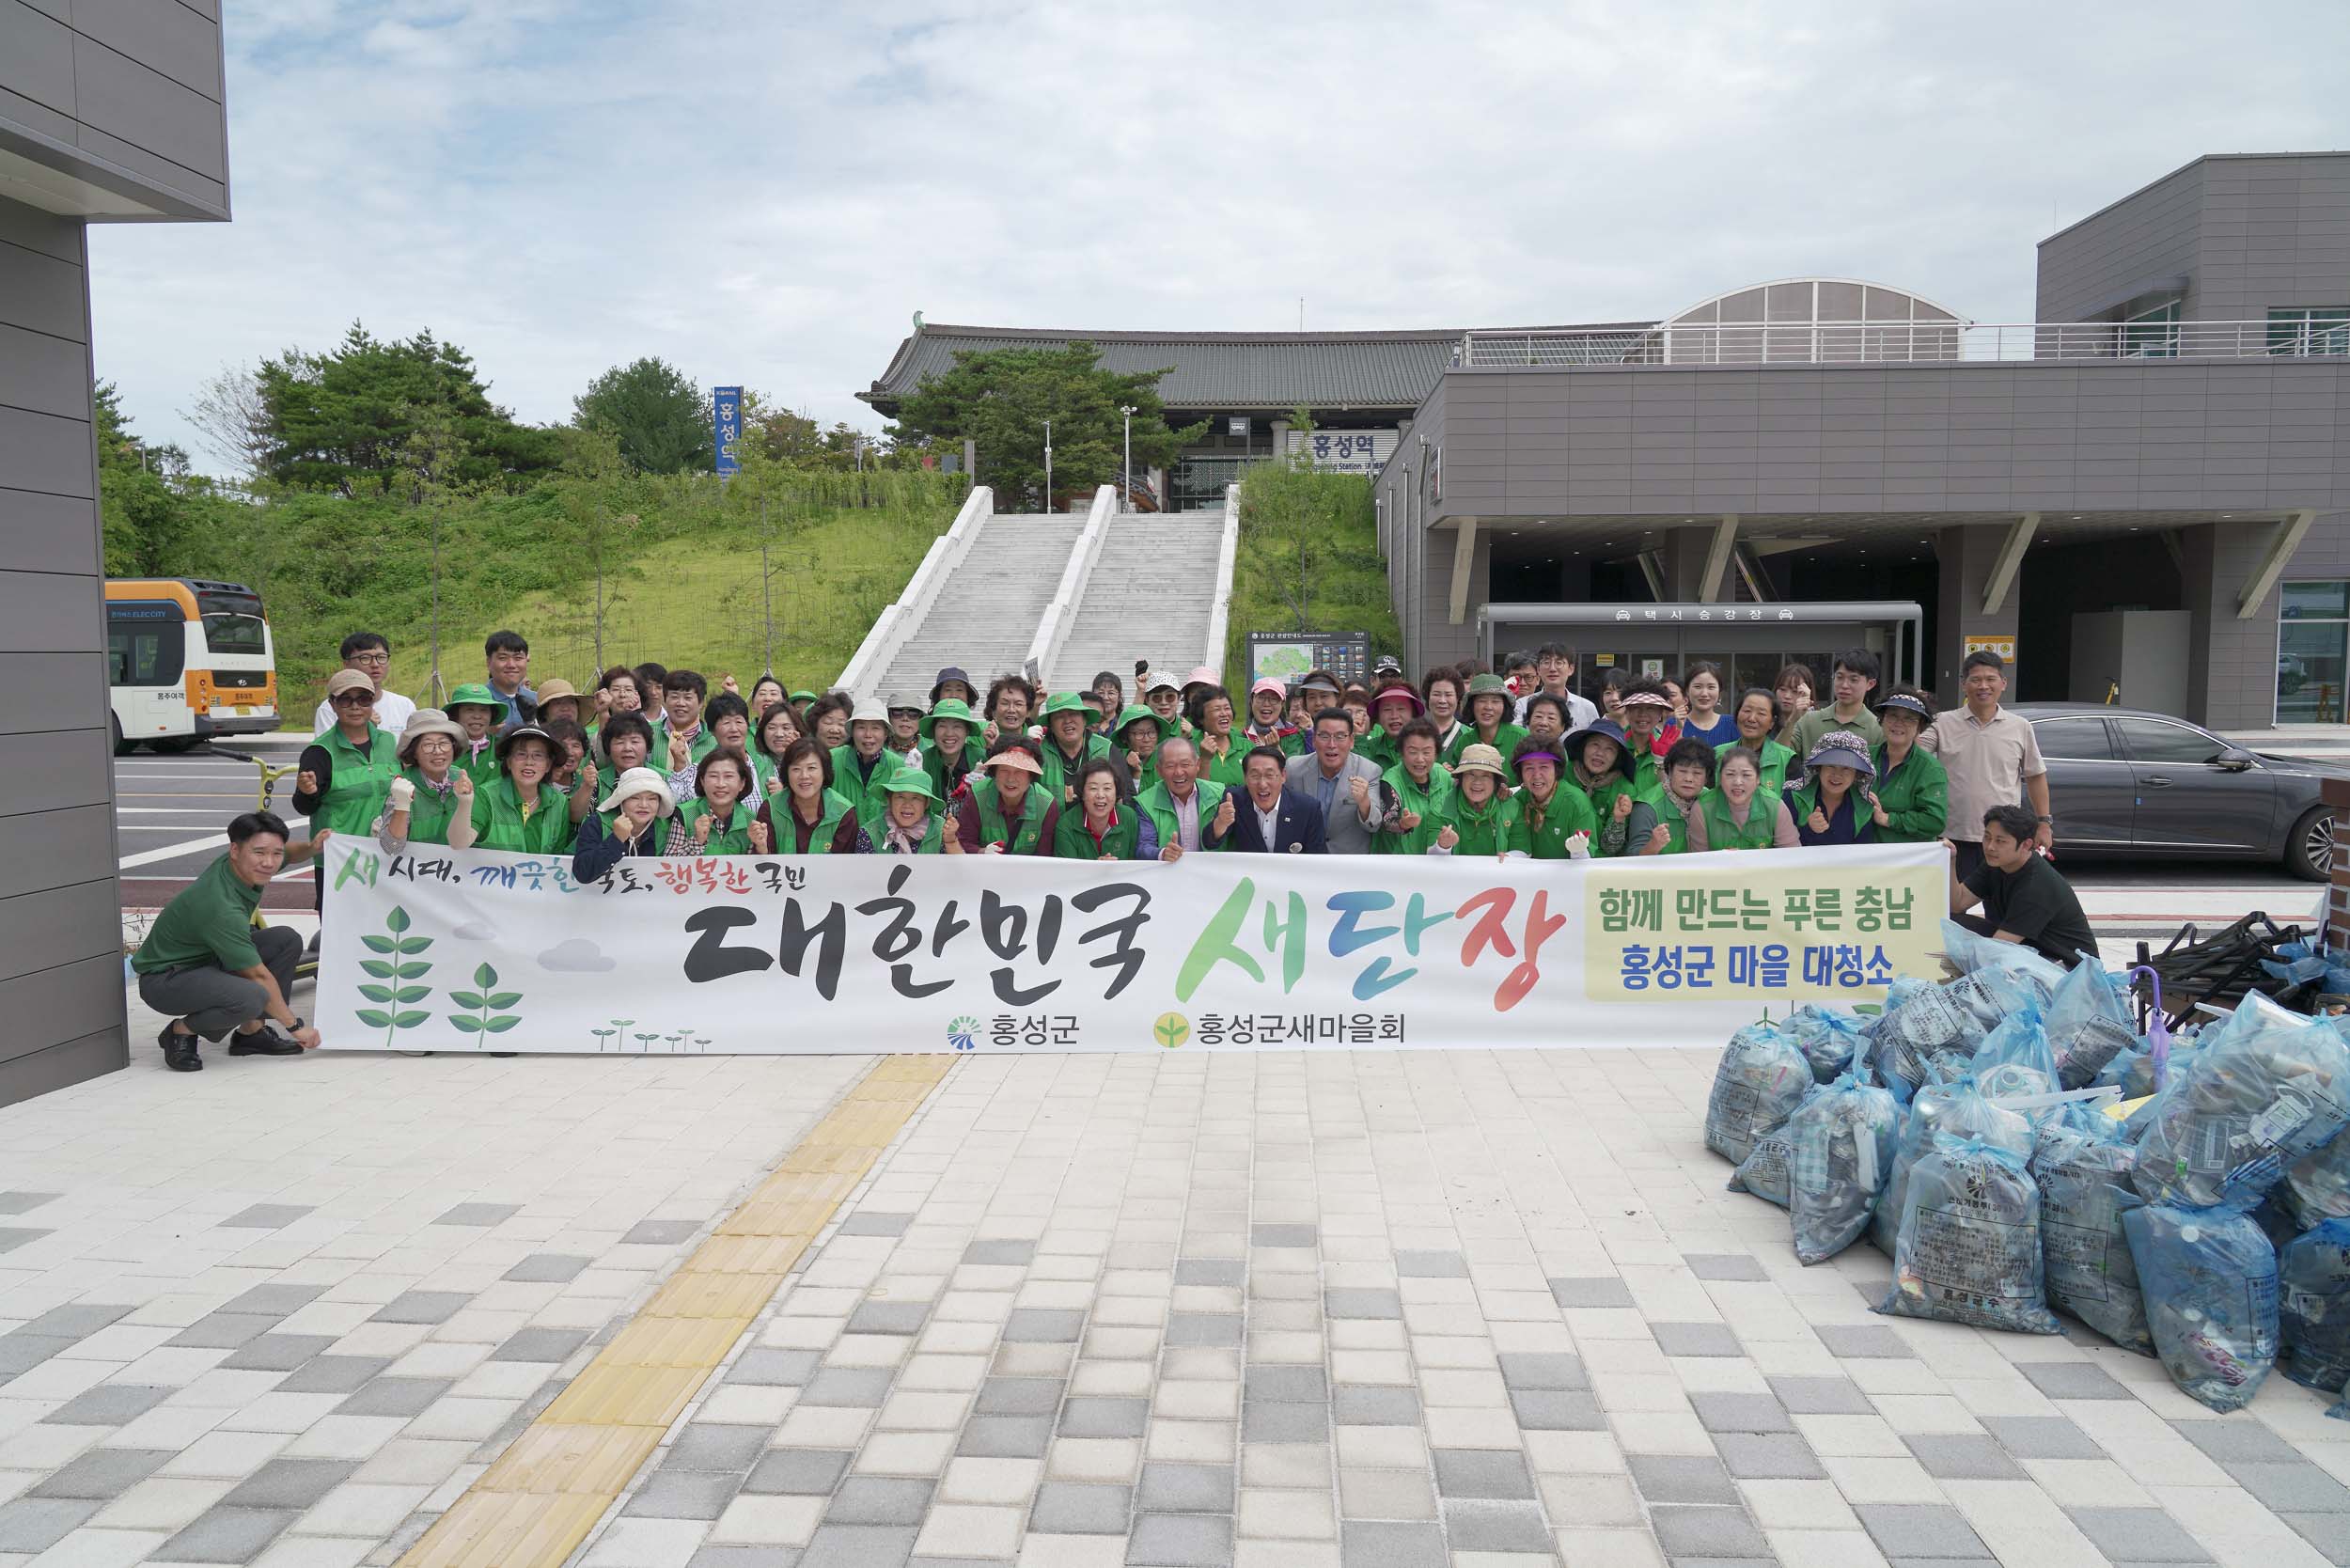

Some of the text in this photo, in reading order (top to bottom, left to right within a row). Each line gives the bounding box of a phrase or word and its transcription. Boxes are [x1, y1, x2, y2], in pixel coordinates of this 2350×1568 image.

[1312, 435, 1373, 458] 홍성역
[335, 847, 380, 892] 새
[388, 857, 461, 884] 시대,
[470, 857, 580, 893] 깨끗한
[655, 857, 752, 894] 행복한
[755, 861, 806, 893] 국민
[1599, 886, 1915, 933] 함께 만드는 푸른 충남
[683, 863, 1567, 1013] 대한민국 새단장
[1621, 944, 1894, 991] 홍성군 마을 대청소
[989, 1014, 1080, 1046] 홍성군
[1197, 1013, 1405, 1045] 홍성군새마을회
